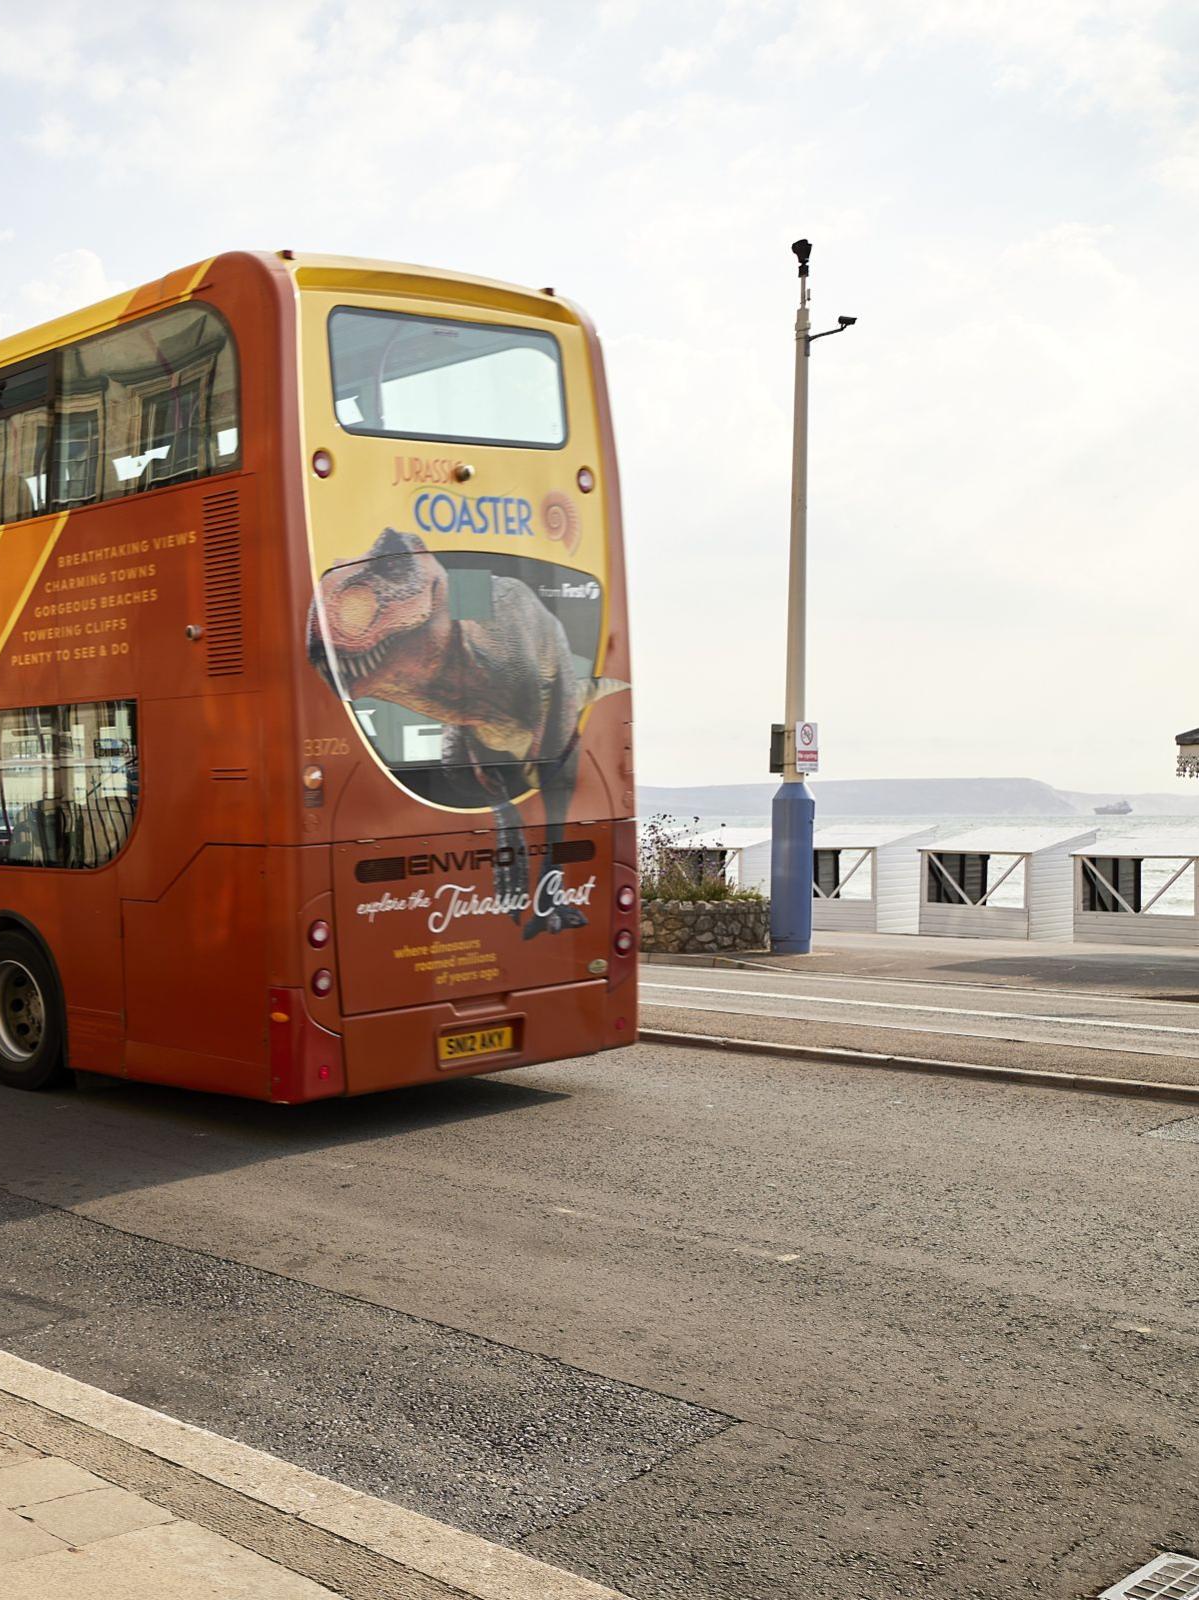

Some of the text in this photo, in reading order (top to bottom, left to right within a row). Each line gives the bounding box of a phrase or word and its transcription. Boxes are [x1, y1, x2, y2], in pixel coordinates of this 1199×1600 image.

[414, 494, 534, 536] COASTER
[58, 531, 197, 568] BREATHTAKING VIEWS
[44, 564, 156, 593] CHARMING TOWNS
[34, 588, 158, 618] GORGEOUS BEACHES
[22, 618, 128, 642] TOWERING CLIFFS
[11, 642, 130, 666] PLENTY TO SEE & DO
[303, 738, 351, 756] 33726
[356, 870, 596, 934] explore the Jurassic Coast
[393, 939, 481, 958] where dinosaurs
[414, 955, 456, 971] roamed
[435, 968, 500, 986] of years ago
